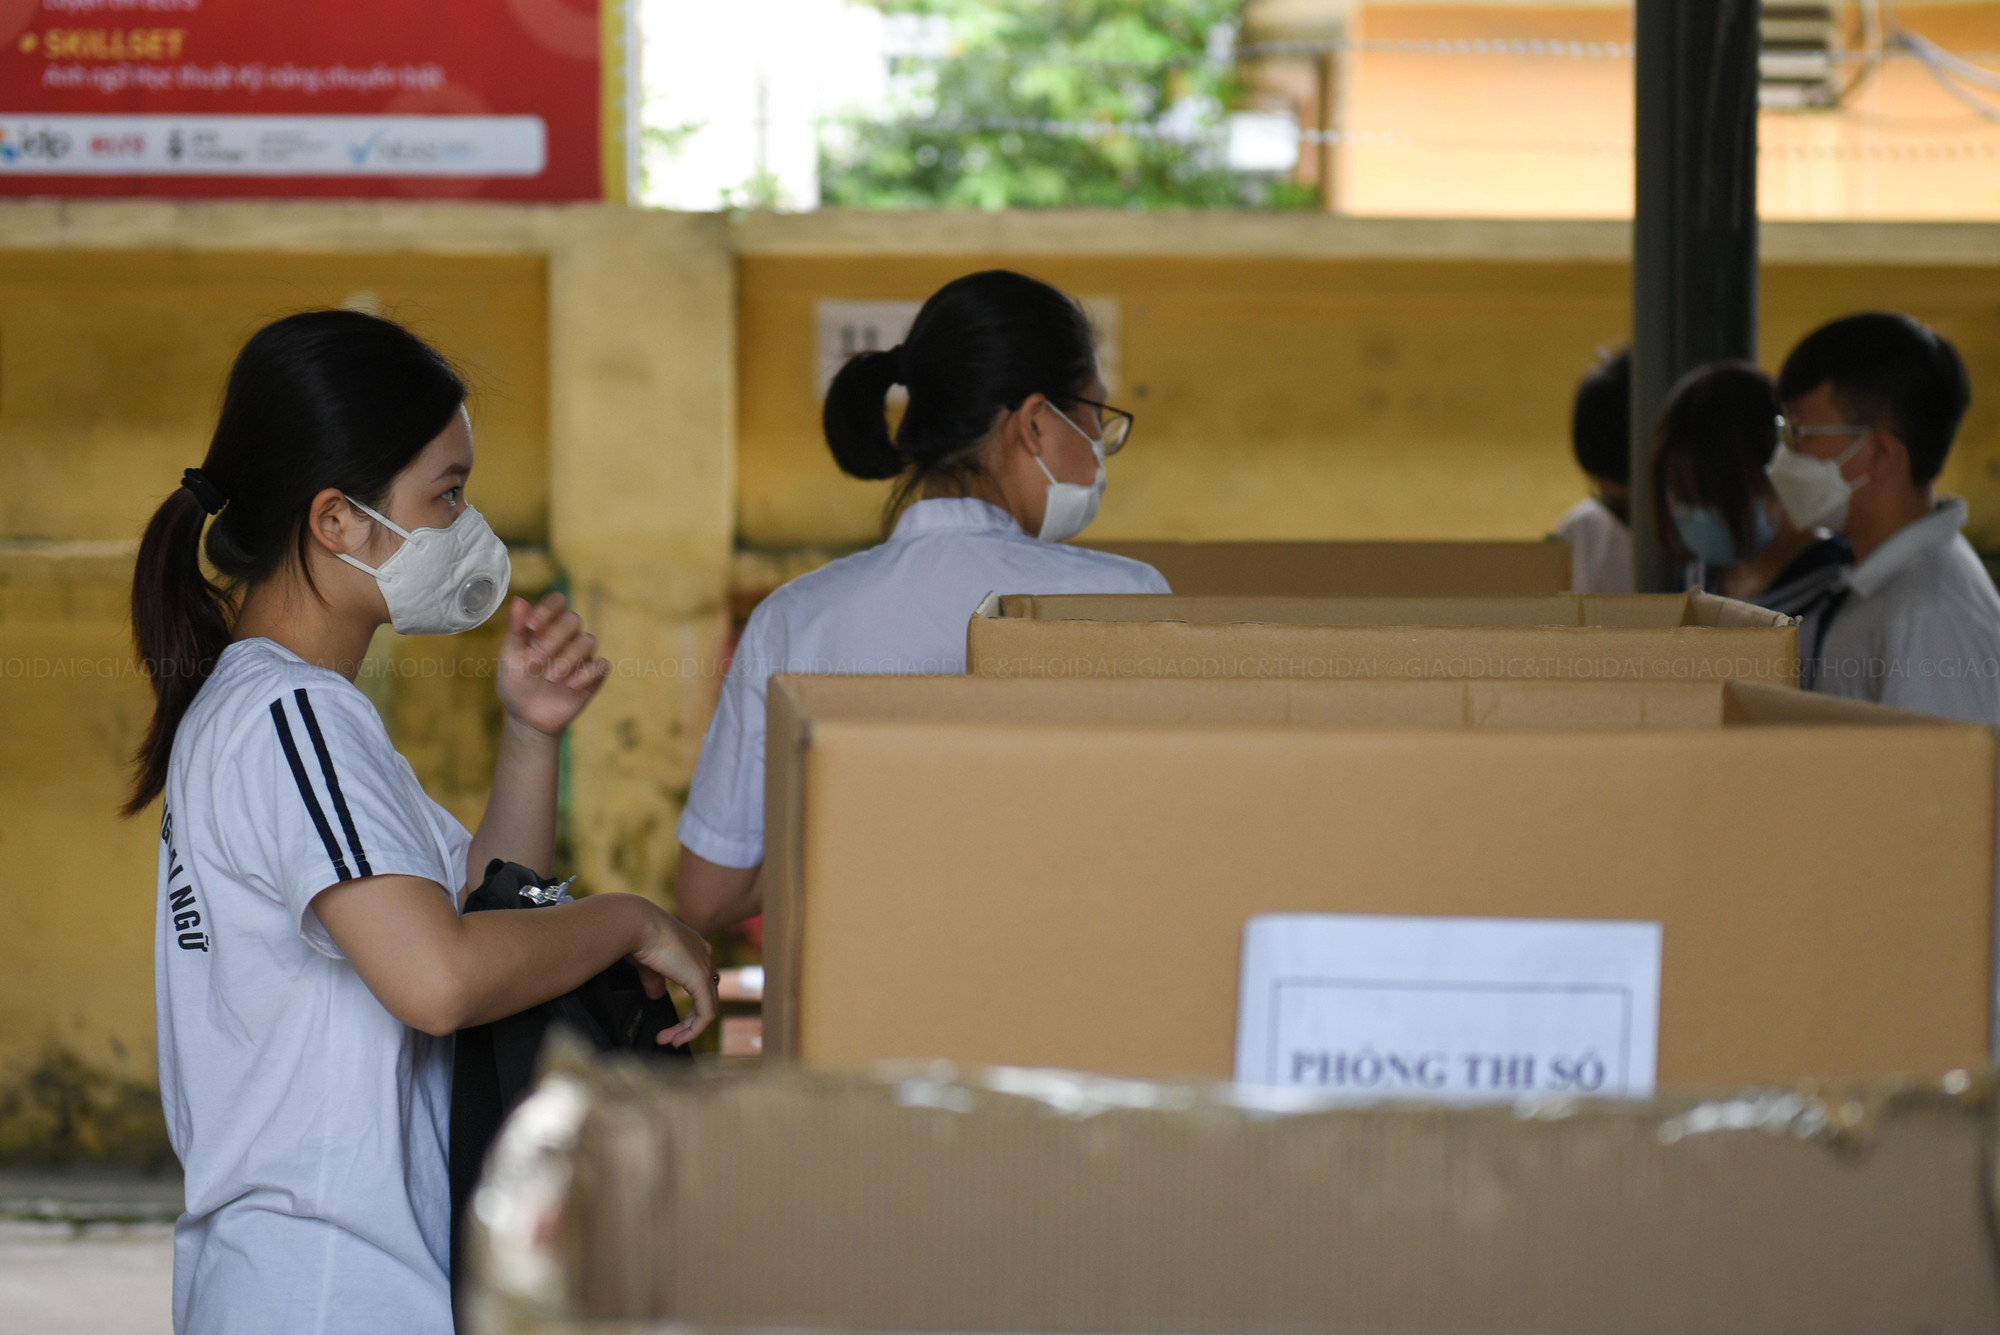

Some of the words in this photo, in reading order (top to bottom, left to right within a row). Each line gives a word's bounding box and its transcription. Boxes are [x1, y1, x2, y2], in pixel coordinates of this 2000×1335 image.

[45, 28, 186, 59] SKILLSET
[169, 885, 209, 952] NGỮ
[1464, 1054, 1534, 1088] THI
